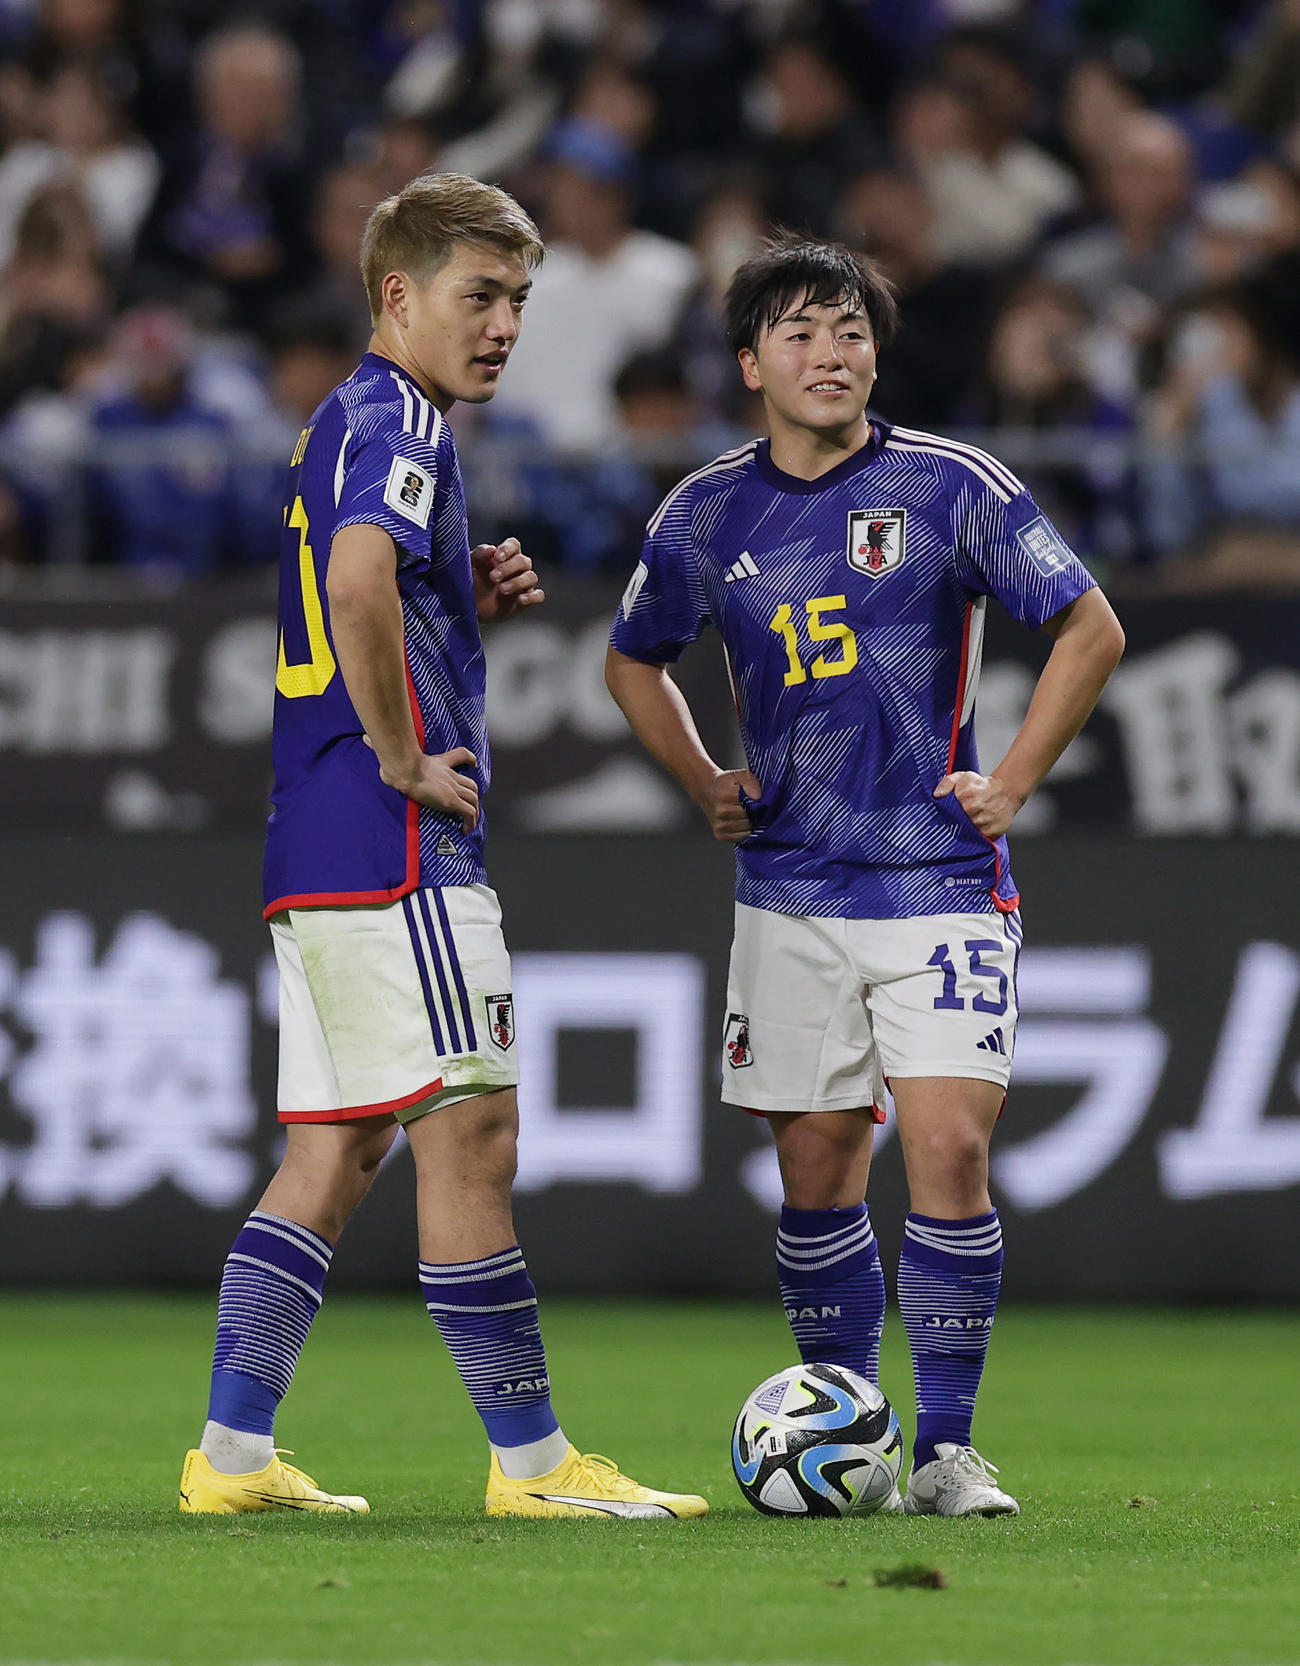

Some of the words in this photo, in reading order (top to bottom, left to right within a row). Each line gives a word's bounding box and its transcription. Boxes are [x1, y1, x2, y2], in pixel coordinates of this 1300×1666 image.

[863, 511, 892, 519] JAPAN
[863, 555, 888, 565] JFA
[769, 594, 858, 687] 15
[927, 939, 1008, 1017] 15
[925, 1316, 995, 1329] JAPA
[496, 1374, 551, 1395] JAP
